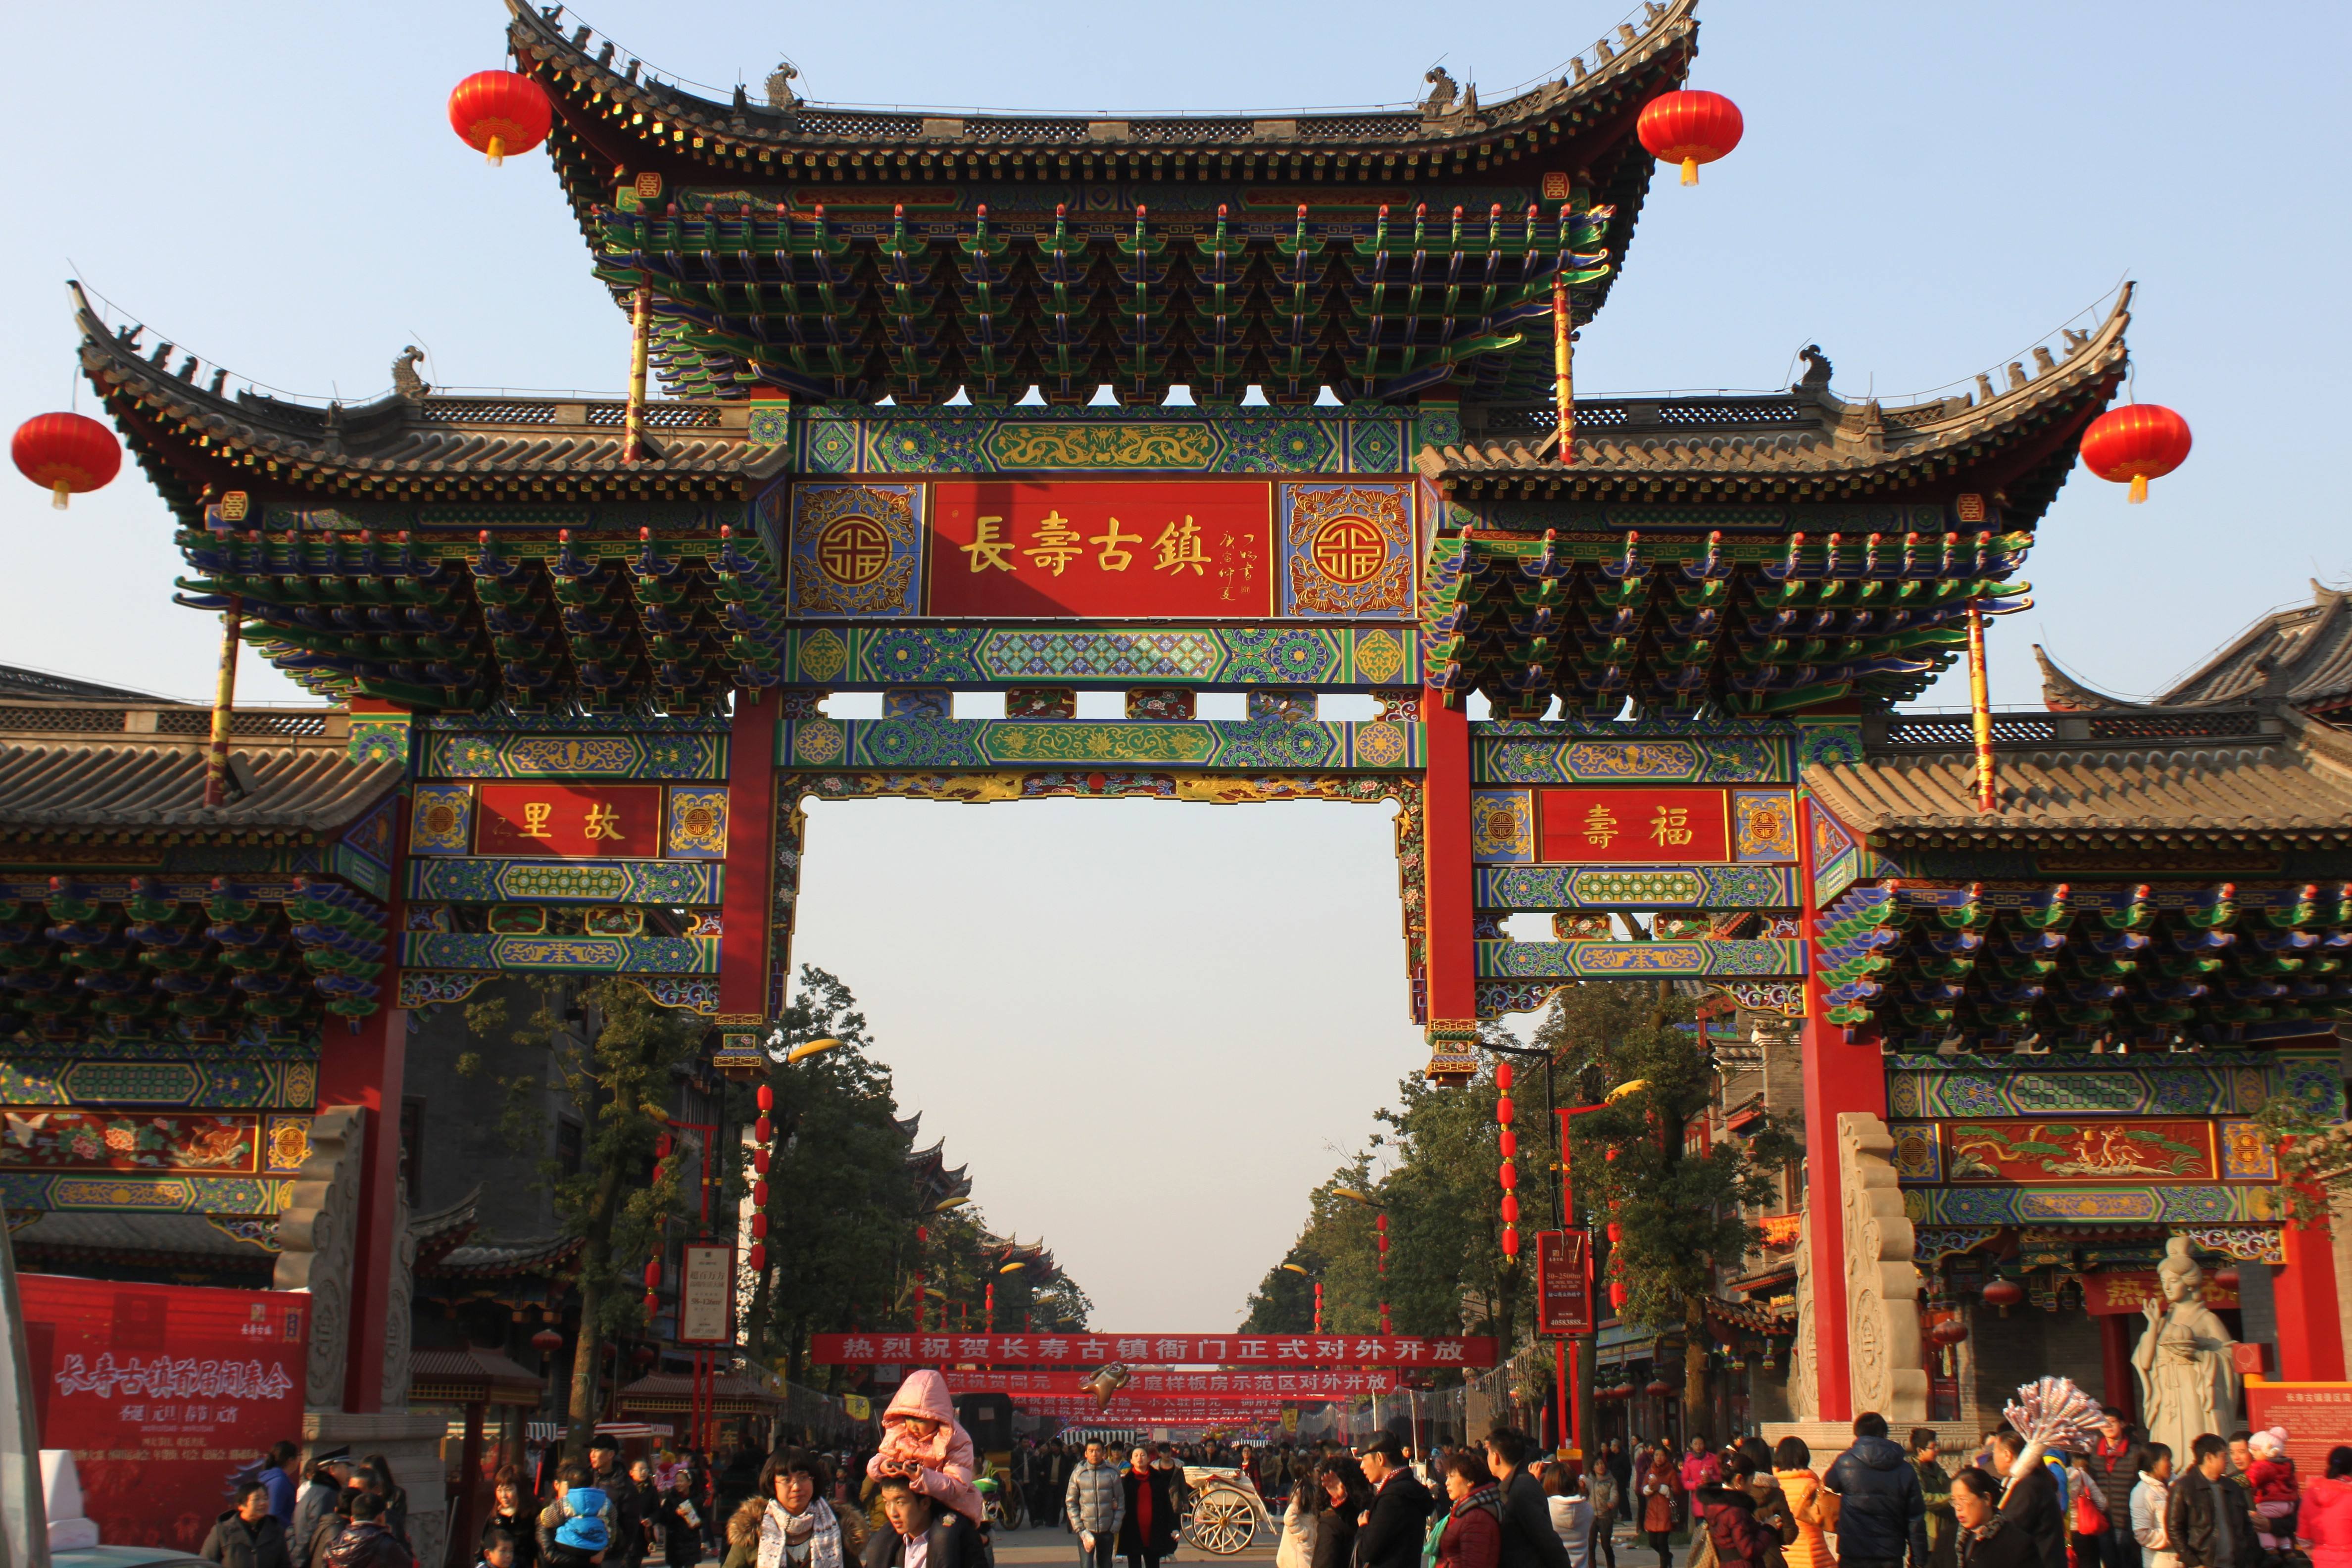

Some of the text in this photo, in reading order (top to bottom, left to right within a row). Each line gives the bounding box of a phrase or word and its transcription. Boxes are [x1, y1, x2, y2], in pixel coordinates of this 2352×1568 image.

[959, 509, 1212, 578] 長壽古鎮
[842, 1337, 1464, 1362] 热烈祝贺长寿古镇衙门正式对外开放
[54, 1352, 294, 1400] 长寿古镇首届闹春会
